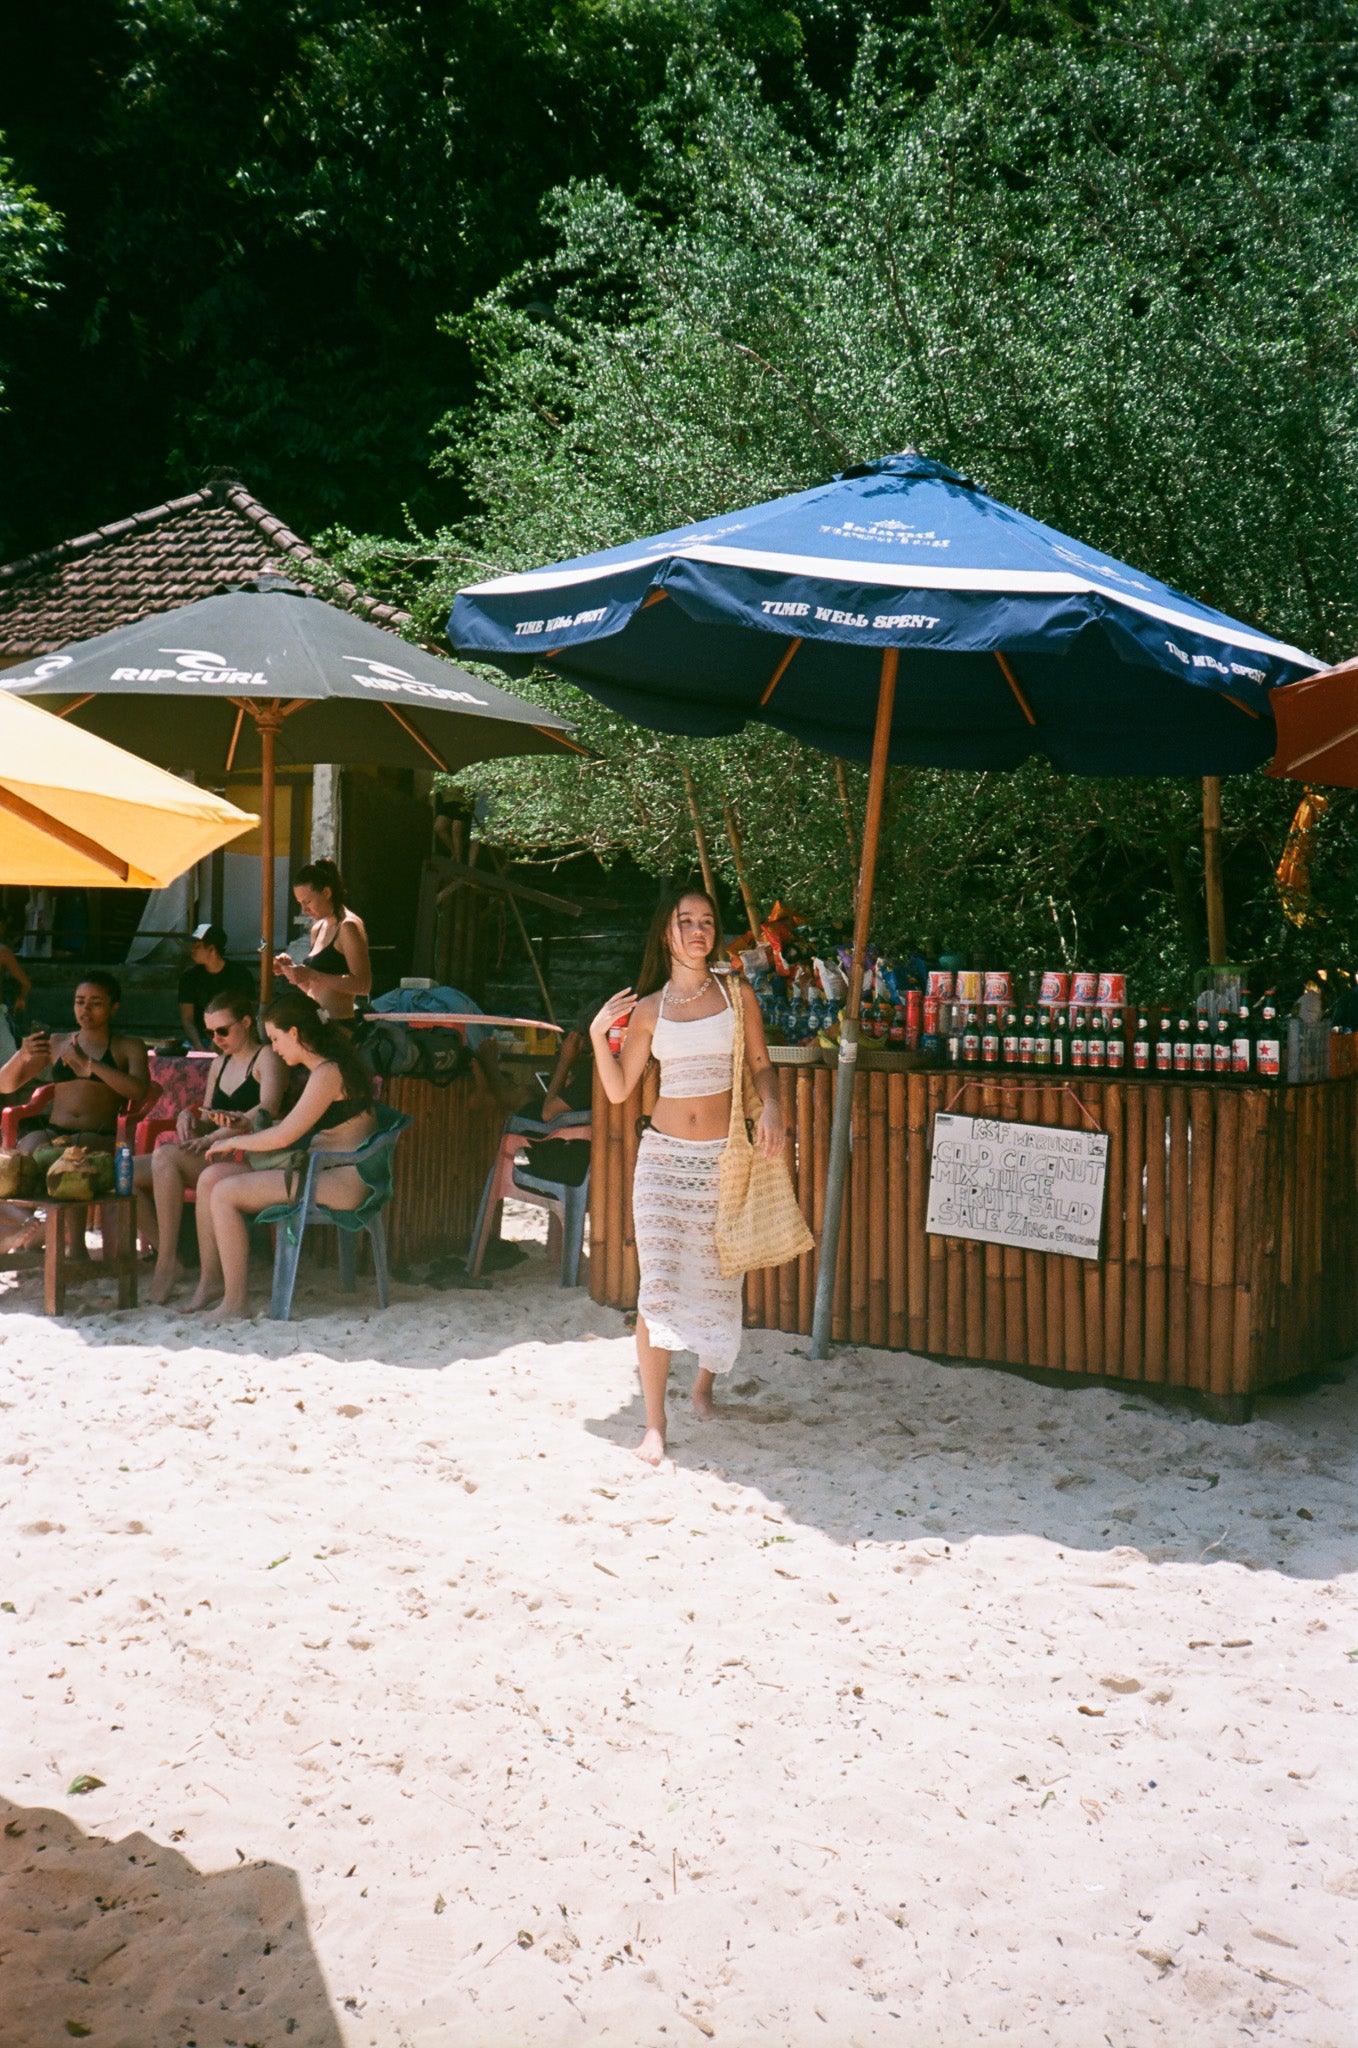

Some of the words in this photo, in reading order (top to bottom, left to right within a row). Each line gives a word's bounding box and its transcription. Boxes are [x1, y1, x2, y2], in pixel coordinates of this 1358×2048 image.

[761, 601, 811, 616] TIME
[814, 606, 869, 628] WELL
[873, 614, 941, 630] SPENT
[935, 1161, 979, 1186] MIX
[986, 1169, 1055, 1198] JUICE
[937, 1141, 993, 1168] COLD
[1000, 1149, 1105, 1185] COCONUT
[953, 1183, 1024, 1213] FRUIT
[1028, 1195, 1095, 1225] SALAD
